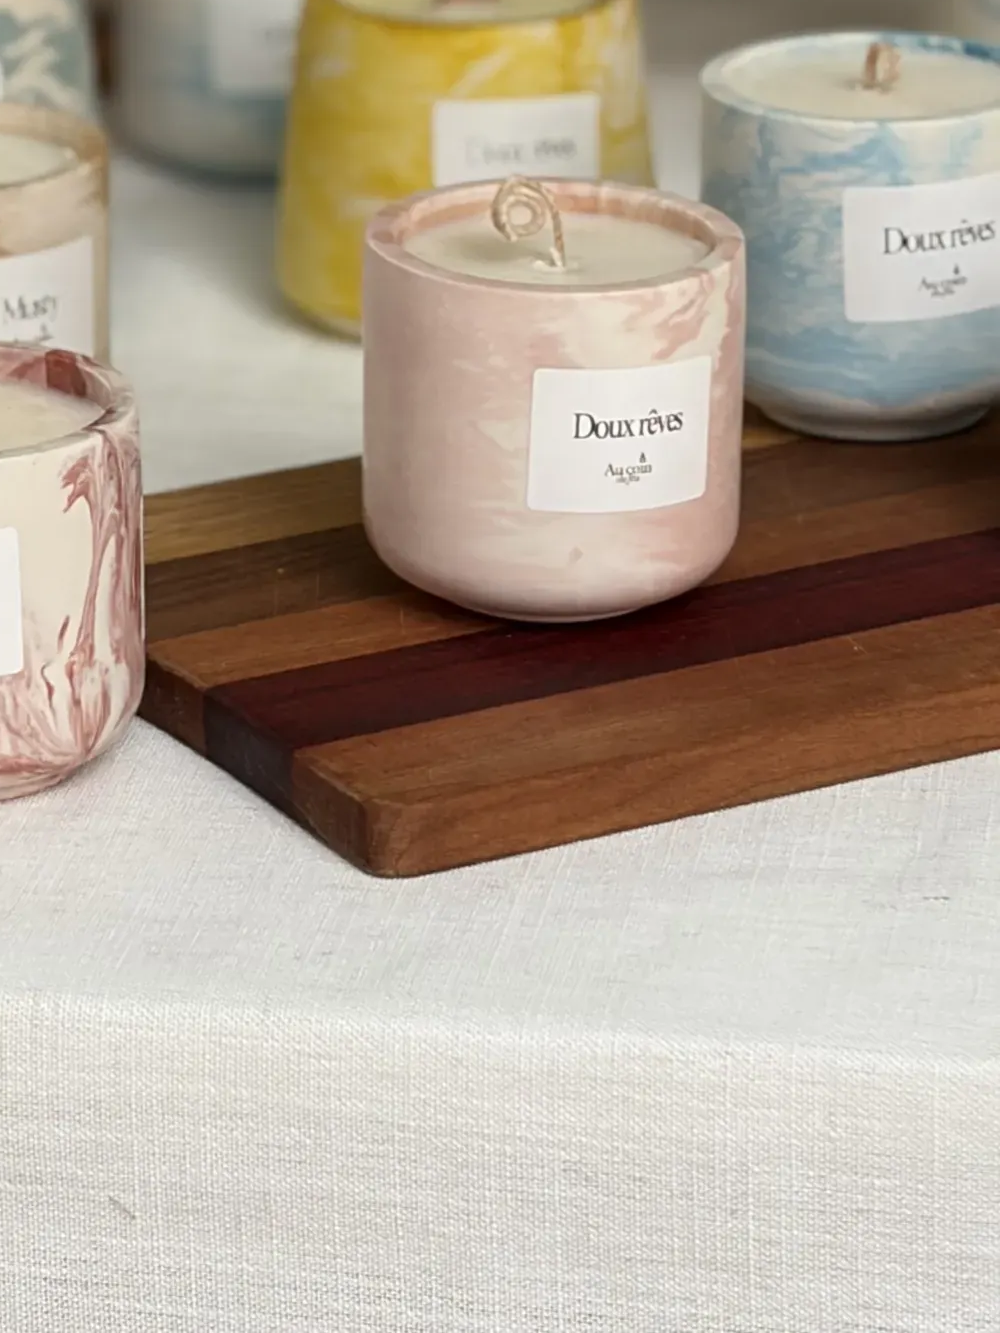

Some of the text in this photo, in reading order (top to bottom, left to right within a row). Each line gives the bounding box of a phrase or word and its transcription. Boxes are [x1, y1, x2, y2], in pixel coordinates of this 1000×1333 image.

[883, 227, 946, 254] Doux
[573, 408, 684, 439] Doux rêves
